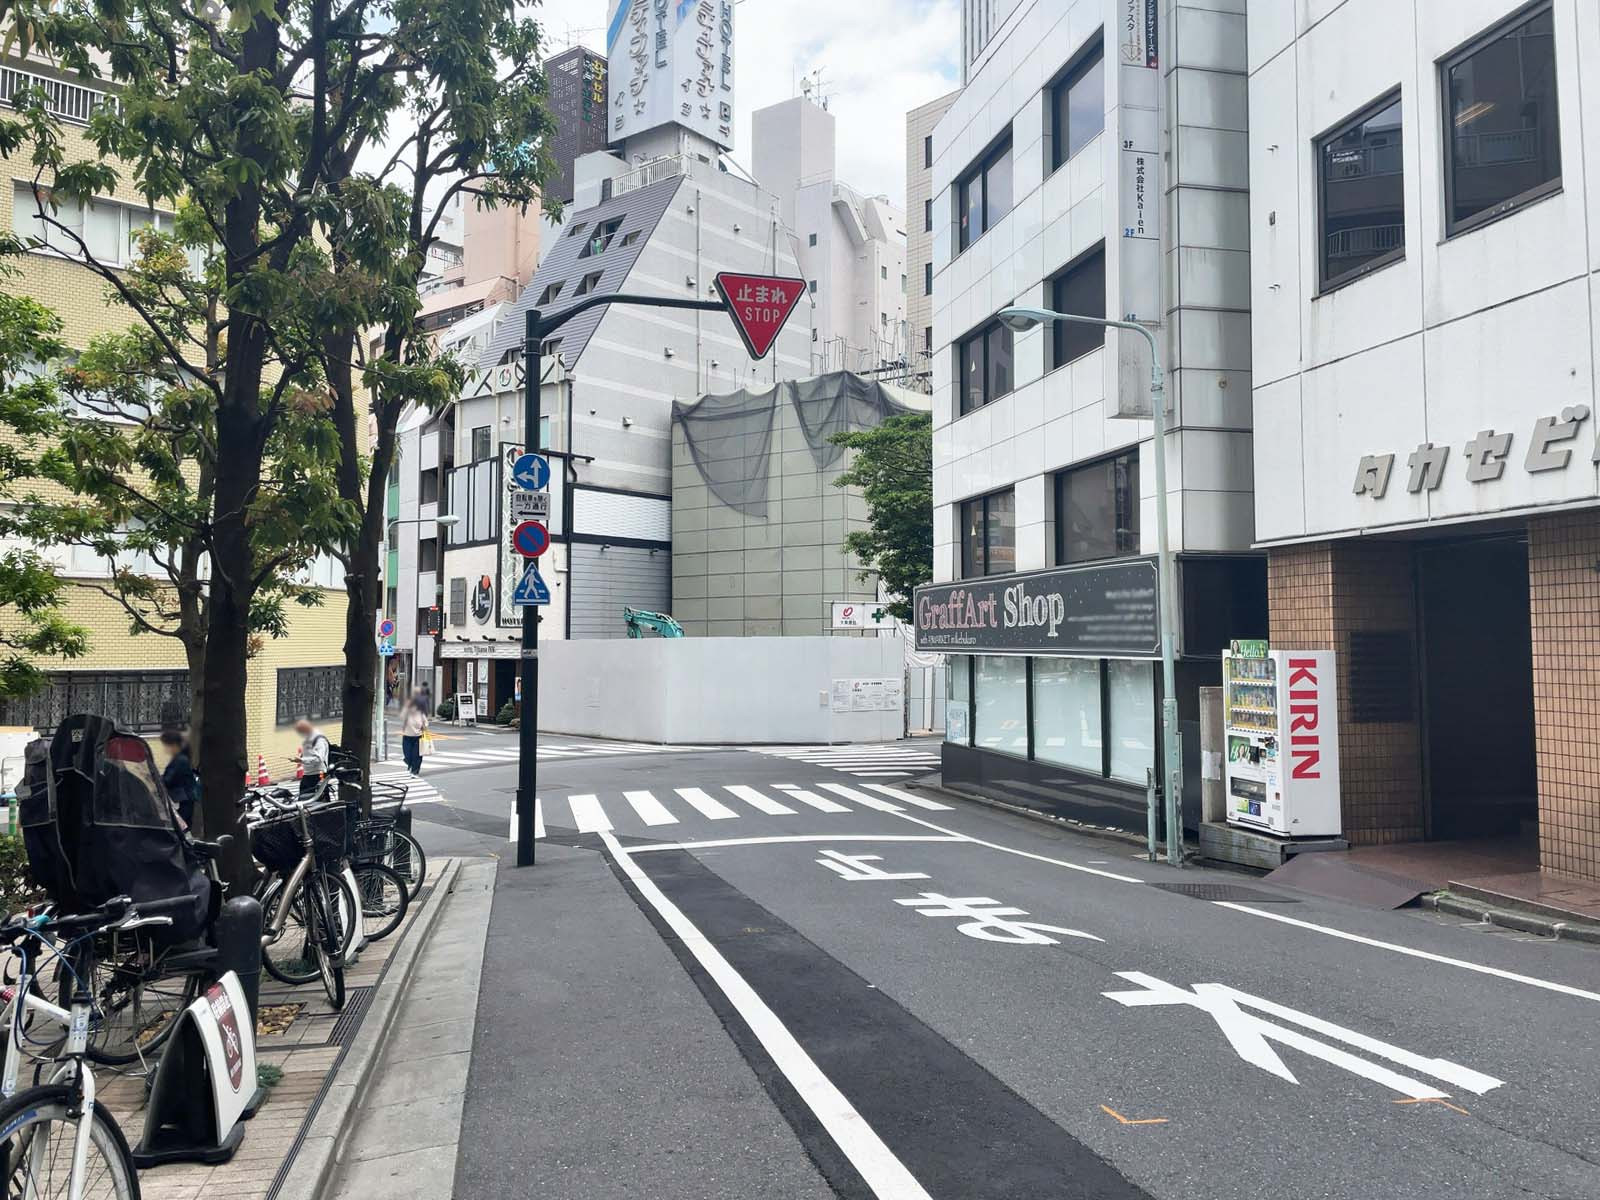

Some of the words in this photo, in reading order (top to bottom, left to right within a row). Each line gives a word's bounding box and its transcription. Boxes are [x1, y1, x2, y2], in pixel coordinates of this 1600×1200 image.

[1123, 140, 1134, 149] 3F
[1125, 228, 1135, 237] 2F
[736, 283, 787, 304] 止まれ
[745, 306, 780, 322] STOP
[1352, 404, 1600, 500] タカセビ
[515, 502, 547, 511] 一方通行
[919, 589, 998, 630] GraffArt
[1003, 582, 1065, 638] Shop
[1288, 658, 1321, 780] KIRIN
